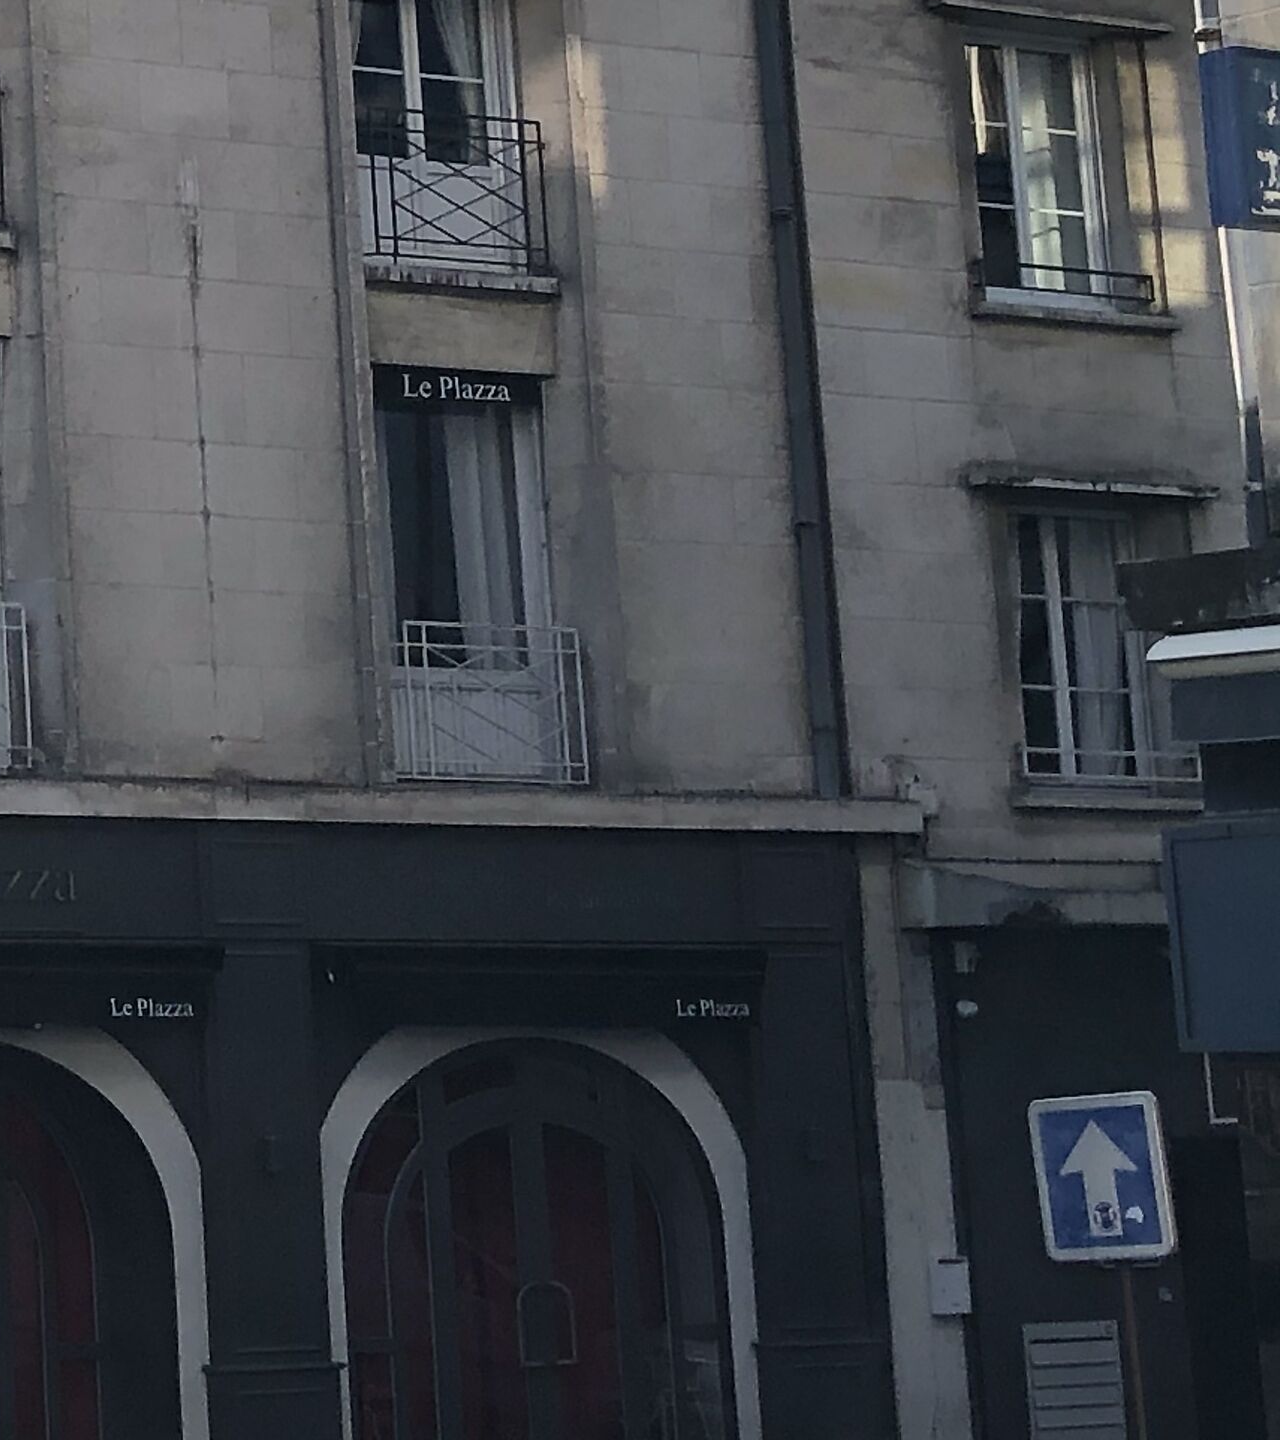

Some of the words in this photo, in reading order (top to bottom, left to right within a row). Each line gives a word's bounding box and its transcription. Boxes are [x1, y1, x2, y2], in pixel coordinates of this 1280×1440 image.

[402, 373, 432, 399] Le
[439, 375, 511, 402] Plazza
[109, 997, 133, 1018] Le
[137, 997, 195, 1019] Plazza
[675, 998, 696, 1017] Le
[698, 998, 750, 1017] Plazza
